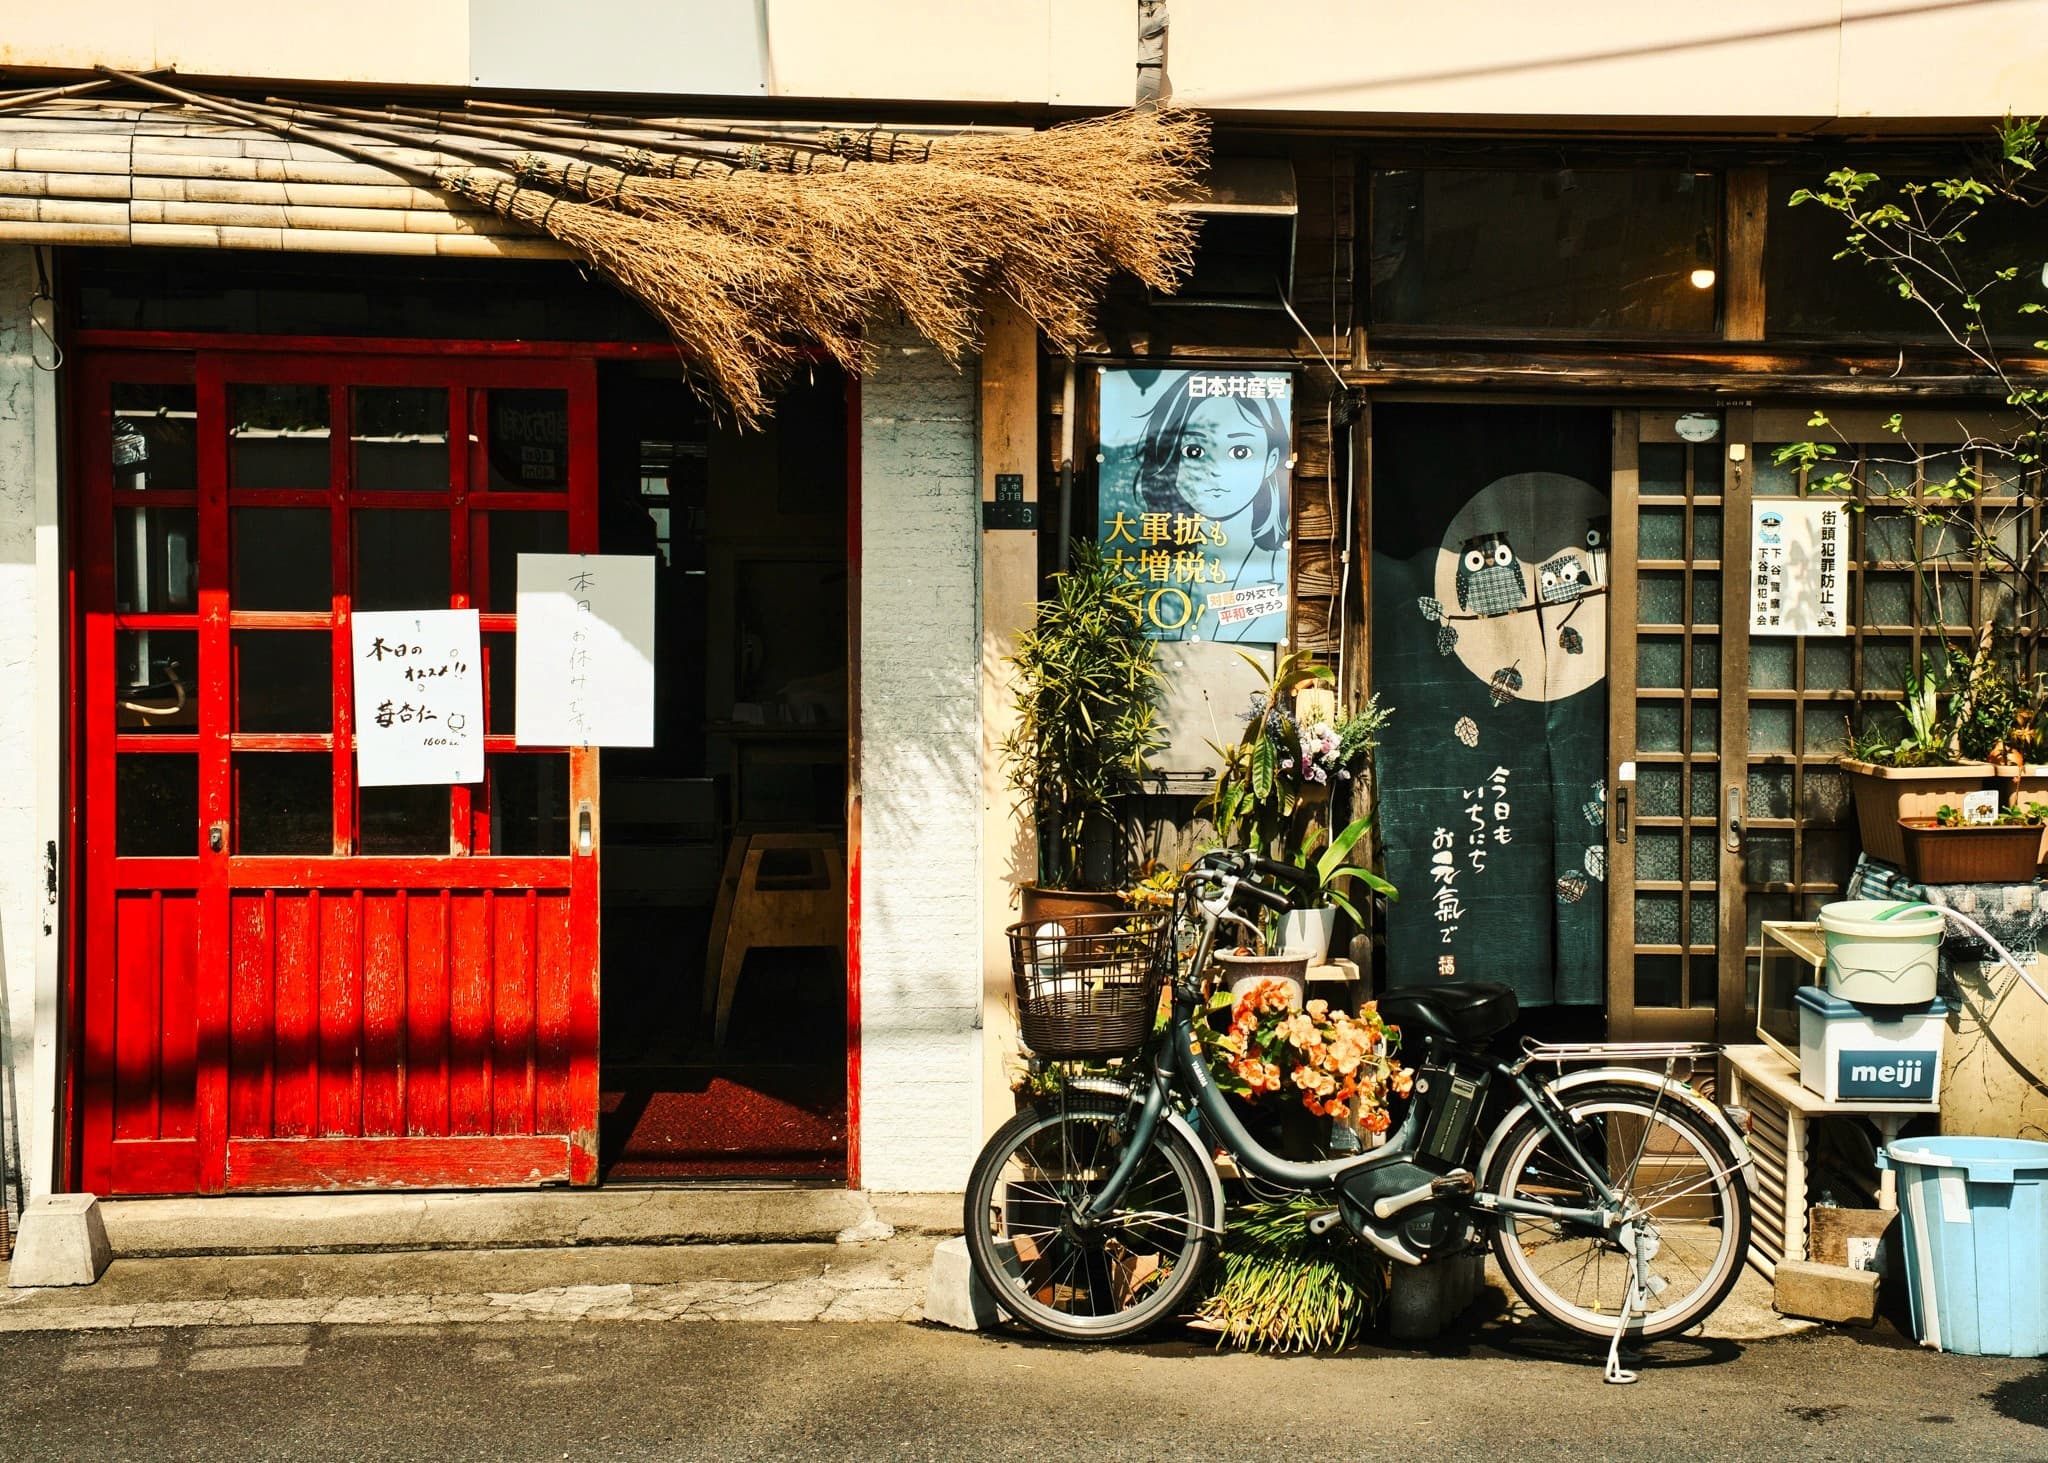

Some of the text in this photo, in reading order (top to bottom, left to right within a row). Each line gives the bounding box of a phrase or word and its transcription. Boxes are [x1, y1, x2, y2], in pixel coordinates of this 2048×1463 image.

[1189, 376, 1286, 398] 日本共産党
[1104, 511, 1228, 547] 大軍拡も
[1820, 511, 1837, 605] 街頭犯罪防止
[1209, 587, 1277, 607] 対話の外交で
[1757, 548, 1768, 626] 下谷防犯協会
[1770, 548, 1782, 626] 下谷警察署
[1220, 600, 1283, 622] 平和を守ろう
[366, 637, 422, 662] 本日の
[1487, 766, 1512, 844] 今日も
[1463, 787, 1488, 874] いちにち
[1852, 1060, 1921, 1088] meiji
